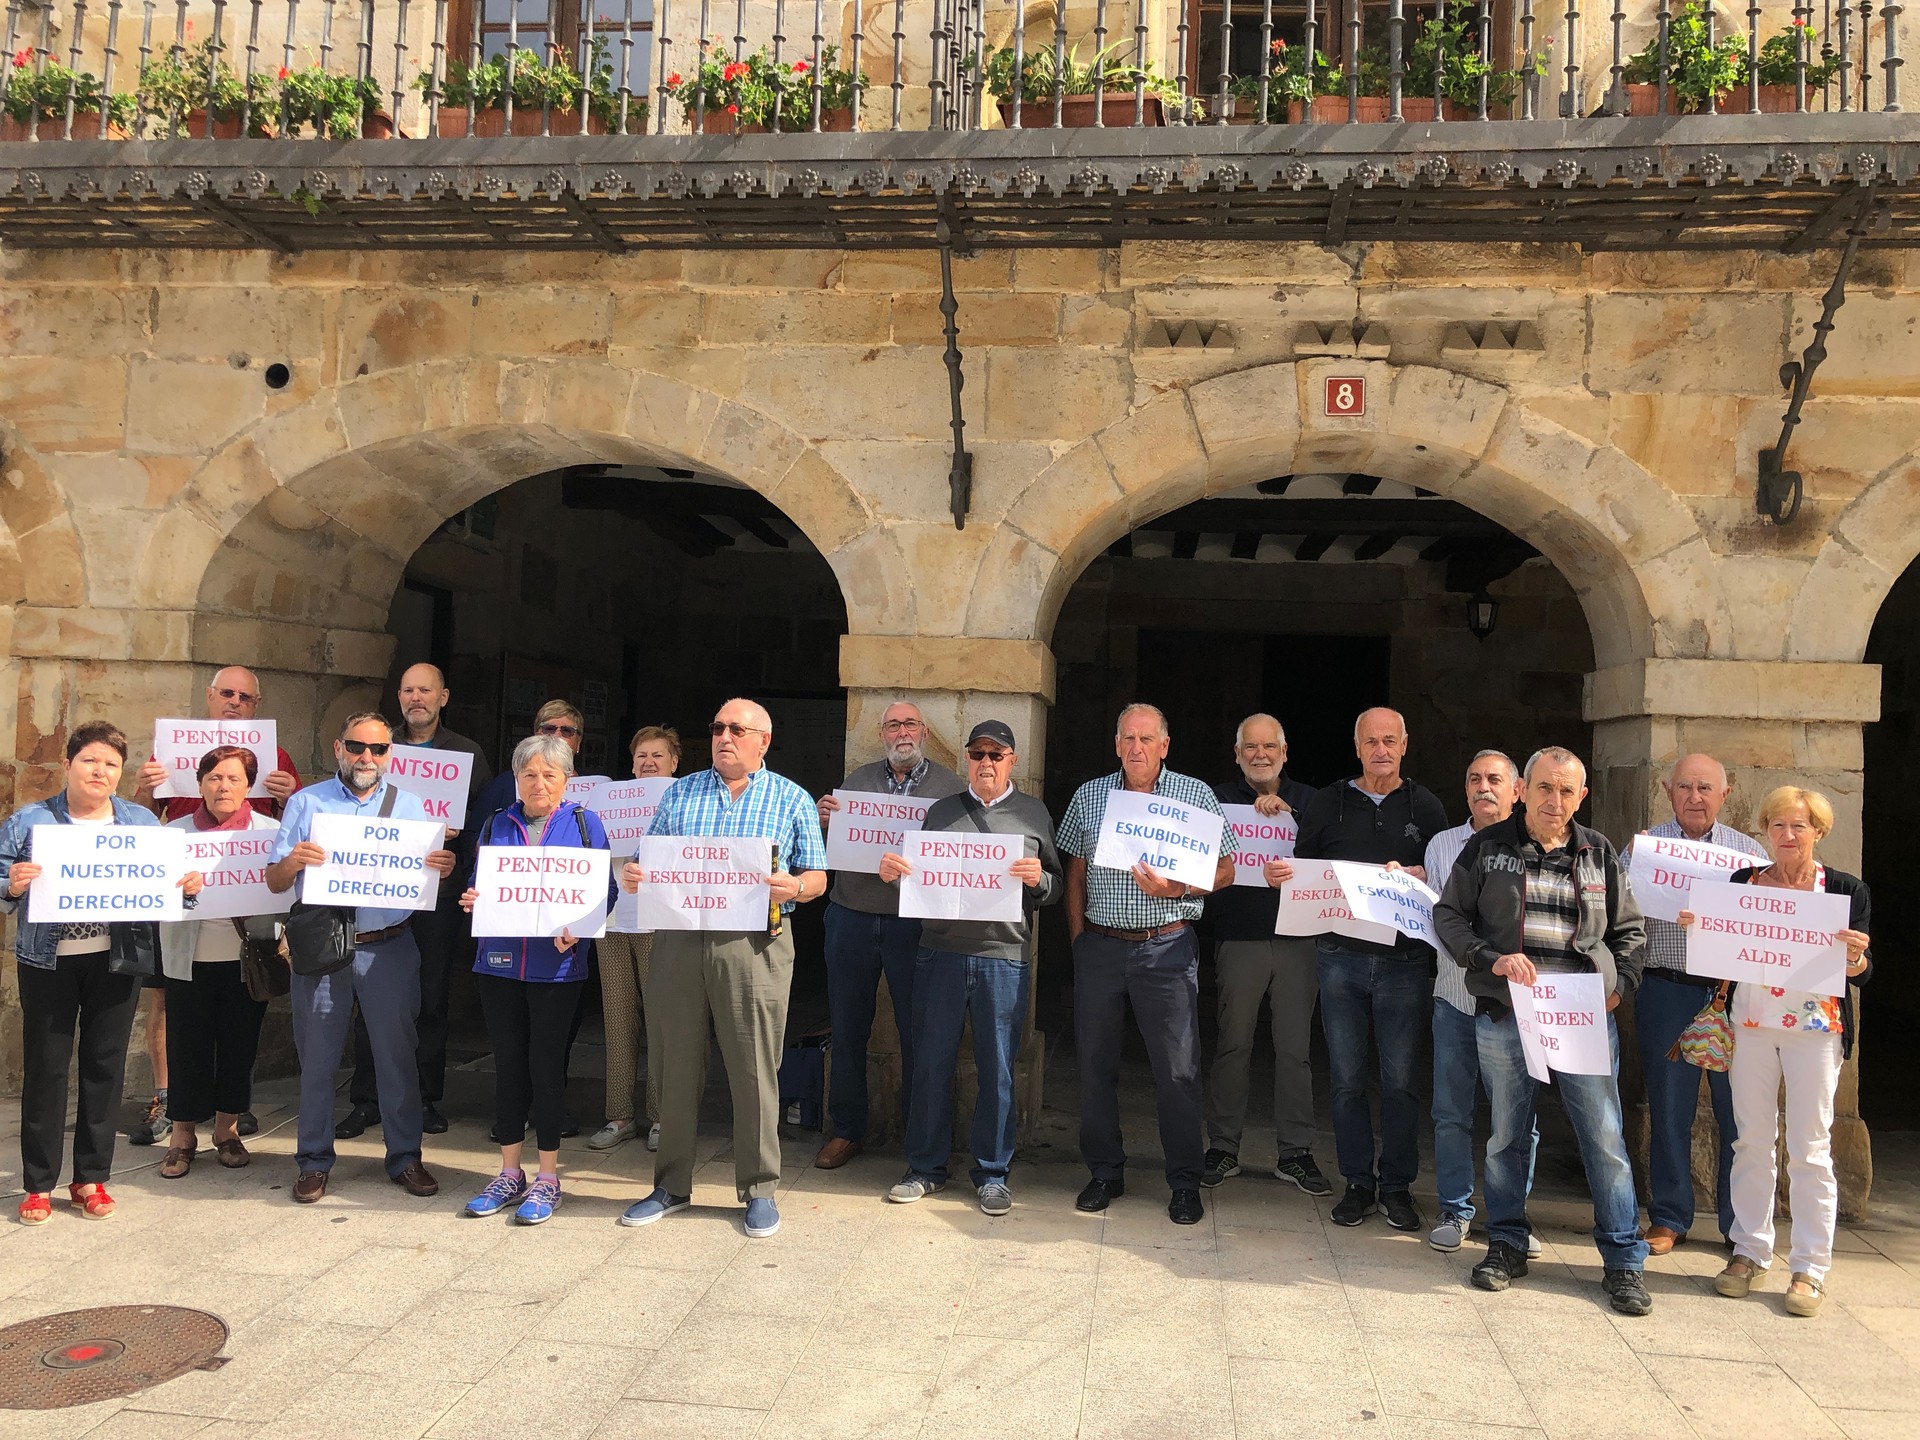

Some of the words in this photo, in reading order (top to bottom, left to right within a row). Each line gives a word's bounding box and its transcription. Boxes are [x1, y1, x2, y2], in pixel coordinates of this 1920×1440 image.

[1336, 384, 1354, 409] 8
[172, 729, 261, 745] PENTSIO
[608, 786, 645, 800] GURE
[596, 806, 658, 820] KUBIDE
[847, 800, 926, 821] PENTSIO
[1147, 802, 1190, 823] GURE
[96, 835, 136, 849] POR
[364, 826, 400, 842] POR
[608, 827, 644, 839] ALDE
[1115, 821, 1210, 855] ESKUBIDEEN
[683, 847, 729, 861] GURE
[920, 841, 1006, 860] PENTSIO
[1653, 840, 1753, 870] PENTSIO
[332, 851, 424, 871] NUESTROS
[496, 857, 591, 875] PENTSIO
[1139, 852, 1178, 871] ALDE
[60, 864, 166, 879] NUESTROS
[650, 870, 760, 884] ESKUBIDEEN
[922, 871, 1002, 889] DUINAK
[1323, 870, 1337, 881] G
[1652, 868, 1702, 891] DUI
[328, 879, 420, 899] DERECHOS
[1379, 872, 1417, 891] GURE
[58, 894, 165, 909] DERECHOS
[498, 887, 586, 905] DUINAK
[681, 896, 727, 909] ALDE
[1292, 889, 1346, 900] ESKUB
[1739, 895, 1796, 915] GURE
[1394, 912, 1428, 936] ALDE
[1700, 917, 1834, 947] ESKUBIDEEN
[1737, 949, 1791, 968] ALDE
